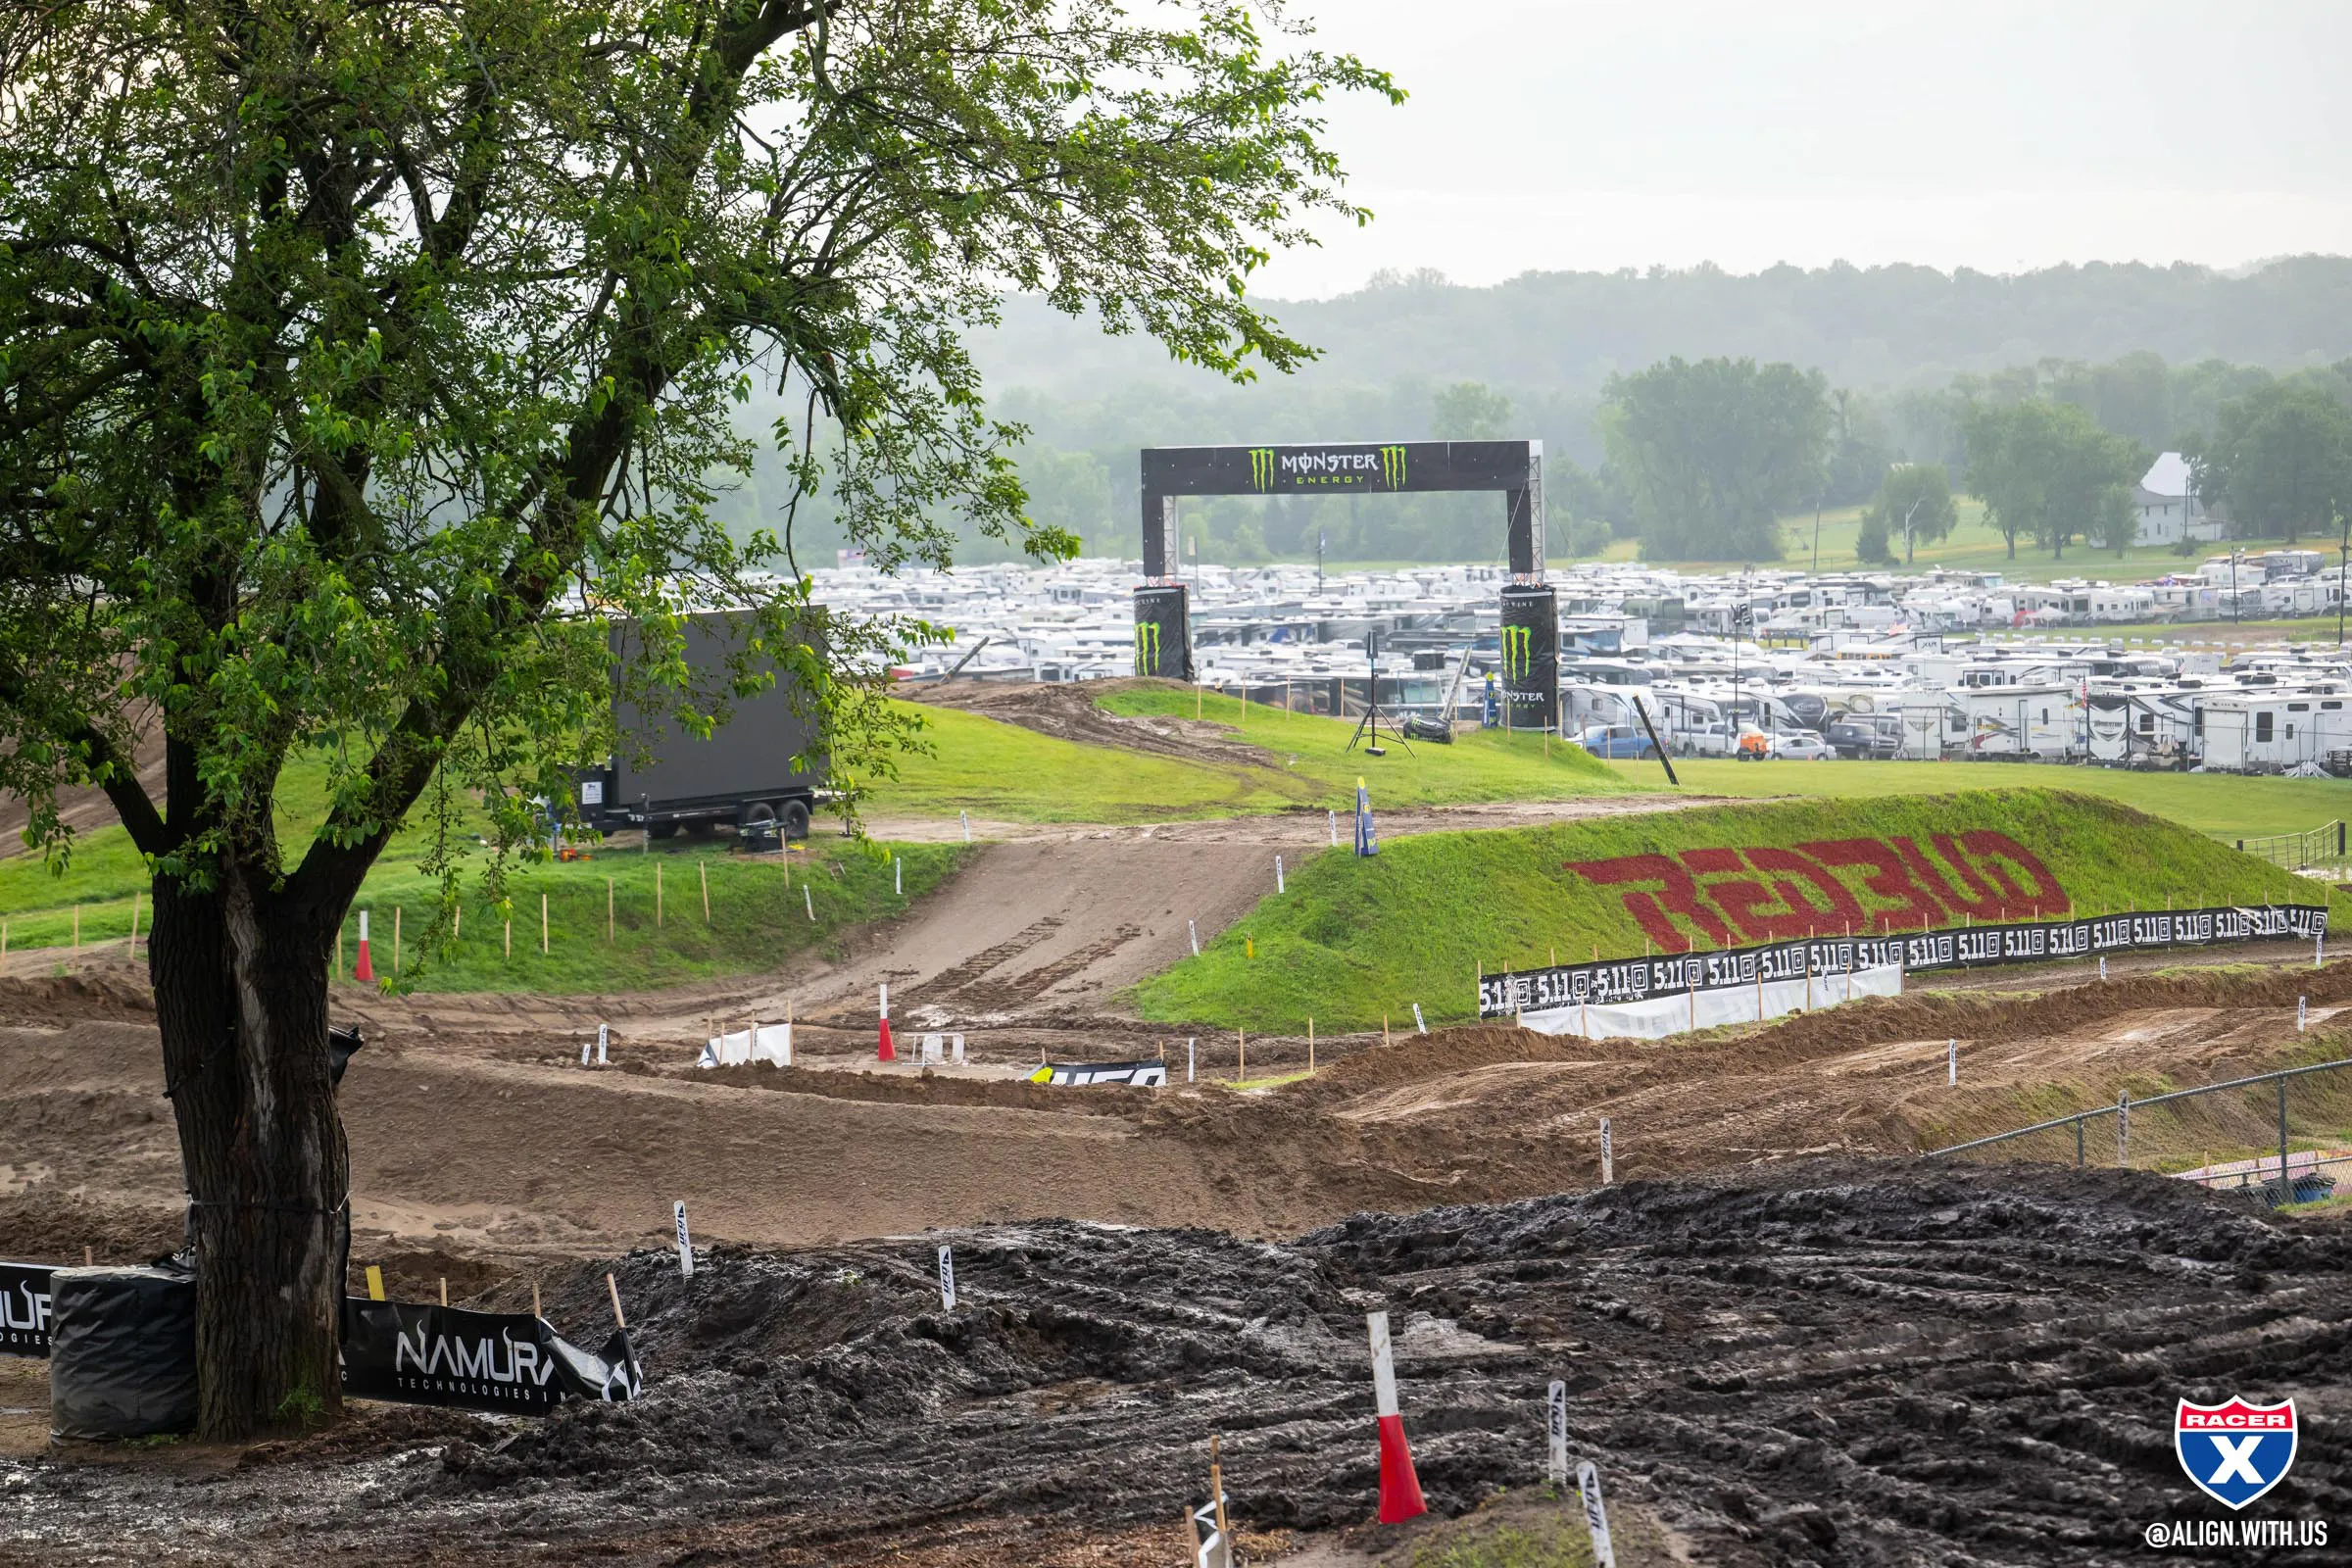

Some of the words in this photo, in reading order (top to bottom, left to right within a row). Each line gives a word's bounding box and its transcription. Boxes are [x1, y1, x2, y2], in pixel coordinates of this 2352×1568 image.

[1281, 453, 1379, 474] MONSTER
[1296, 475, 1364, 484] ENERGY
[1538, 971, 1571, 1004] 5.11
[1597, 963, 1630, 996] 5.11
[1653, 959, 1685, 991] 5.11
[1707, 956, 1740, 986] 5.11
[1762, 948, 1792, 979] 5.11
[1811, 944, 1838, 972] 5.11
[1909, 937, 1938, 966] 5.11
[1958, 932, 1985, 960] 5.11
[2004, 929, 2032, 956] 5.11
[2093, 920, 2119, 949] 5.11
[2133, 916, 2158, 944] 5.11
[2175, 914, 2200, 941] 5.11
[2216, 912, 2239, 938] 5.11
[398, 1376, 530, 1401] TECHNOLOGIES
